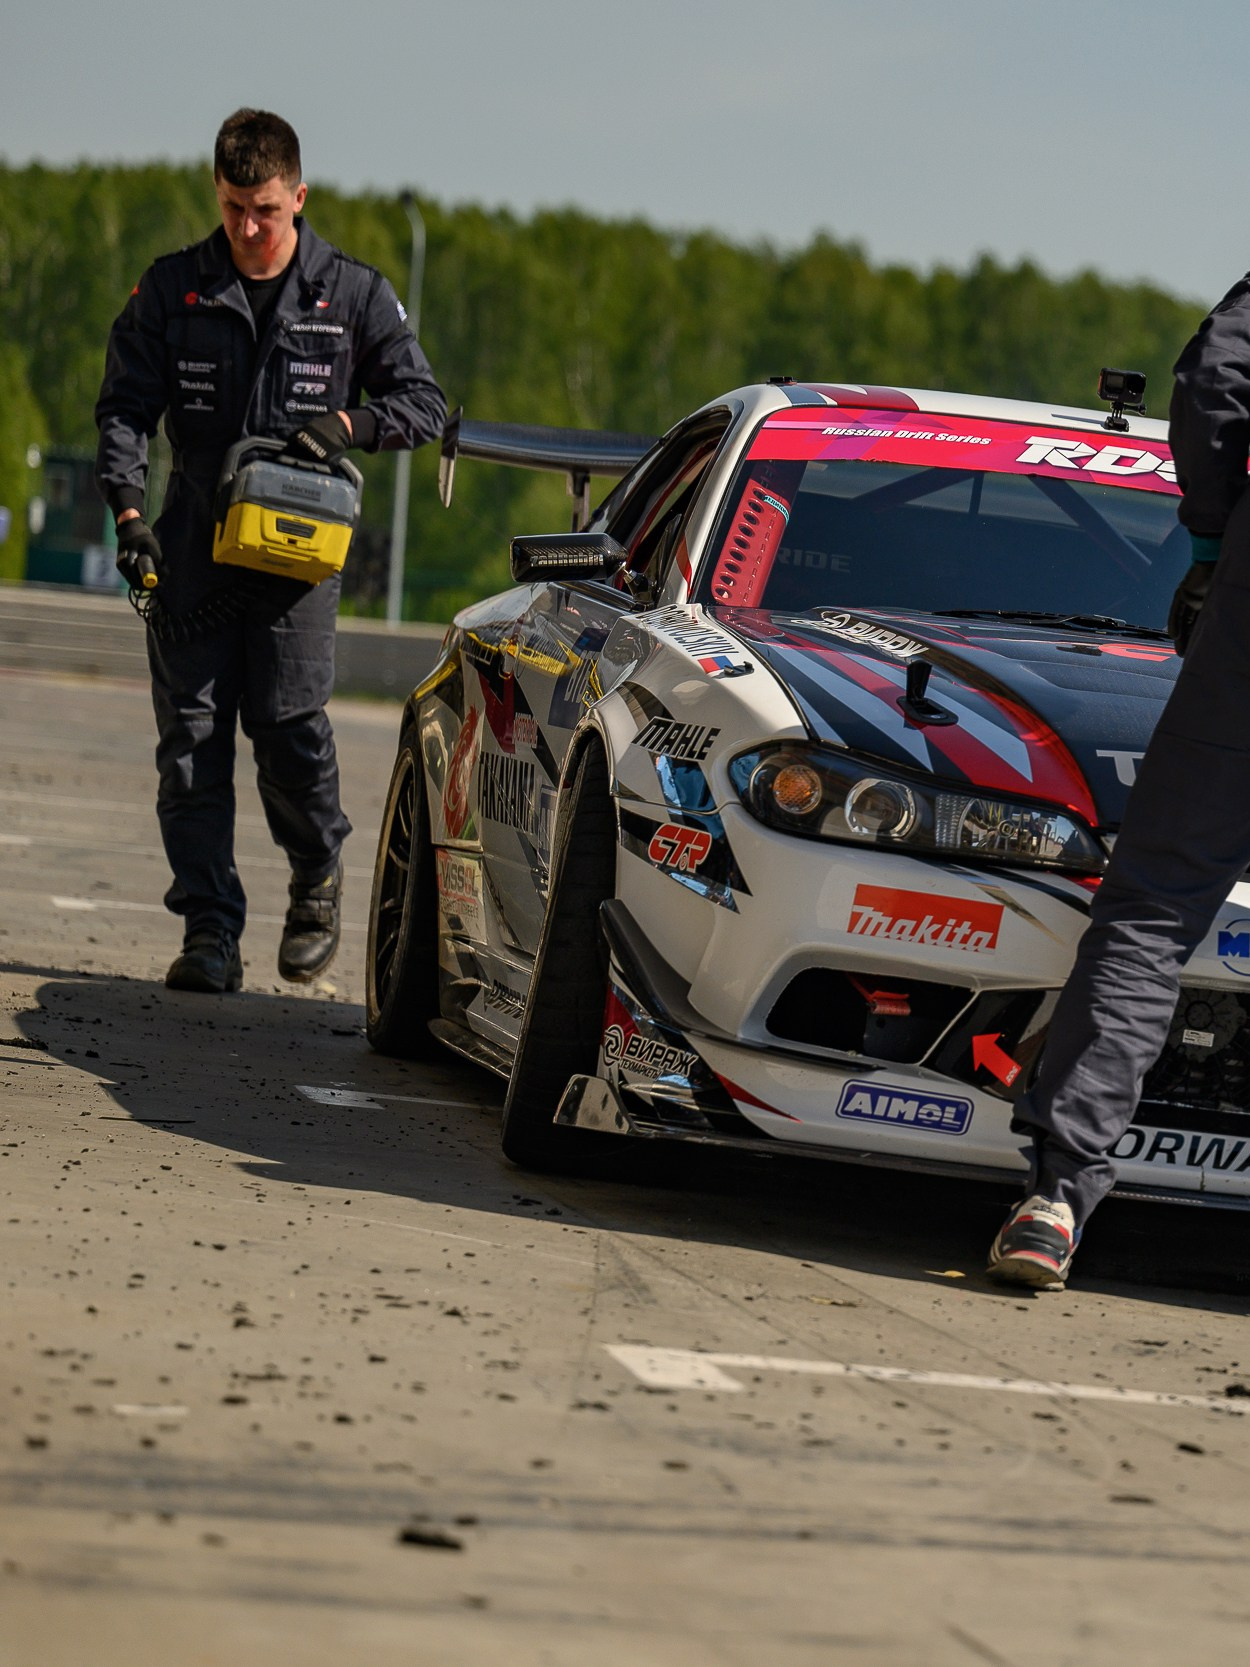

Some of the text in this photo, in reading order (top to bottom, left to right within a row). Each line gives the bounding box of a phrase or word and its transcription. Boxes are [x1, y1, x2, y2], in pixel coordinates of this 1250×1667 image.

[290, 362, 332, 377] MAHLE
[822, 427, 992, 445] Russian Drift Series
[630, 716, 722, 761] MAHLE
[649, 823, 713, 873] CTR
[624, 1033, 699, 1077] ВИРАЖ
[844, 1092, 961, 1127] AIMOL
